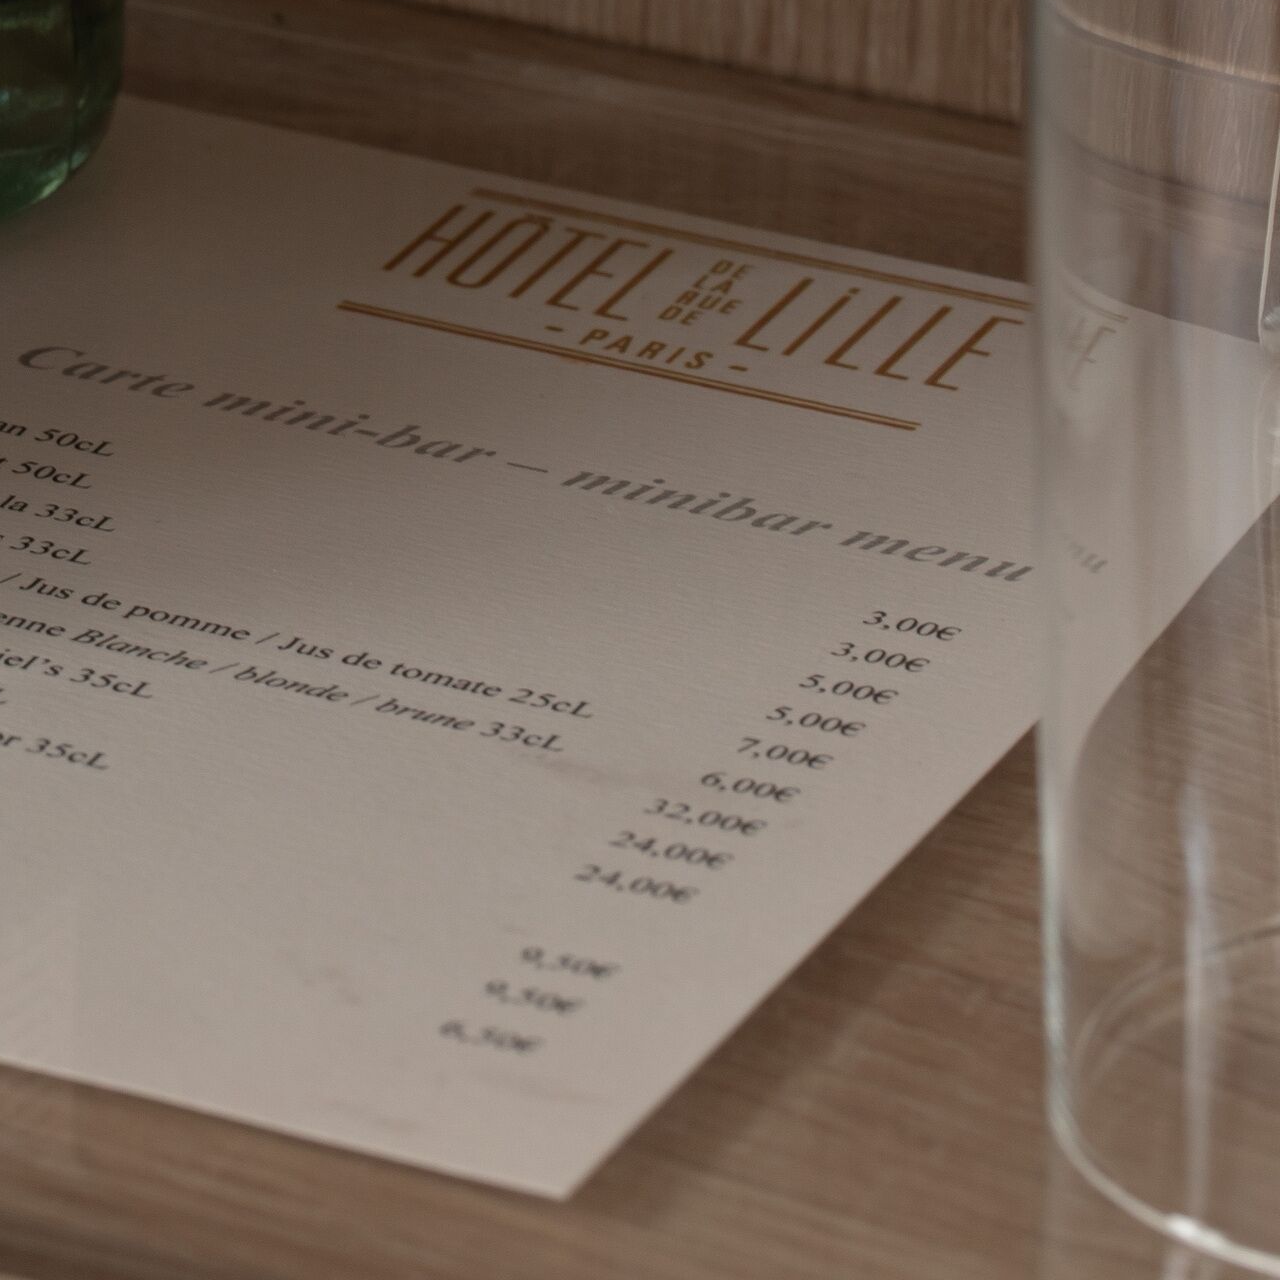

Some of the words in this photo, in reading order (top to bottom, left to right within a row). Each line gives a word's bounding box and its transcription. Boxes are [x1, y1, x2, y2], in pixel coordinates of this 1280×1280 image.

[710, 260, 754, 280] DE
[658, 306, 703, 326] DE
[674, 291, 742, 315] RUE
[579, 328, 714, 371] PARIS
[33, 428, 115, 457] 50cL
[11, 460, 94, 489] 50cL
[18, 345, 196, 398] Carte
[203, 391, 497, 463] mini-bar
[561, 469, 833, 537] minibar
[838, 530, 1035, 582] menu
[34, 503, 116, 533] 33cL
[9, 535, 92, 566] 33cL
[862, 609, 962, 642] 3,00€
[17, 575, 76, 602] Jus
[81, 590, 122, 613] de
[123, 602, 250, 642] pomme
[276, 634, 334, 662] Jus
[341, 651, 383, 672] de
[389, 662, 503, 700] tomate
[508, 686, 596, 720] 25cL
[830, 641, 930, 674] 3,00€
[68, 666, 155, 701] 35cL
[70, 627, 210, 673] Blanche
[233, 666, 351, 706] blonde
[375, 698, 477, 734] brune
[479, 721, 565, 754] 33cL
[799, 673, 900, 705] 5,00€
[766, 705, 867, 738] 5,00€
[24, 736, 111, 771] 35cL
[736, 737, 835, 771] 7,00€
[700, 770, 801, 804] 6,00€
[643, 797, 769, 838] 32,00€
